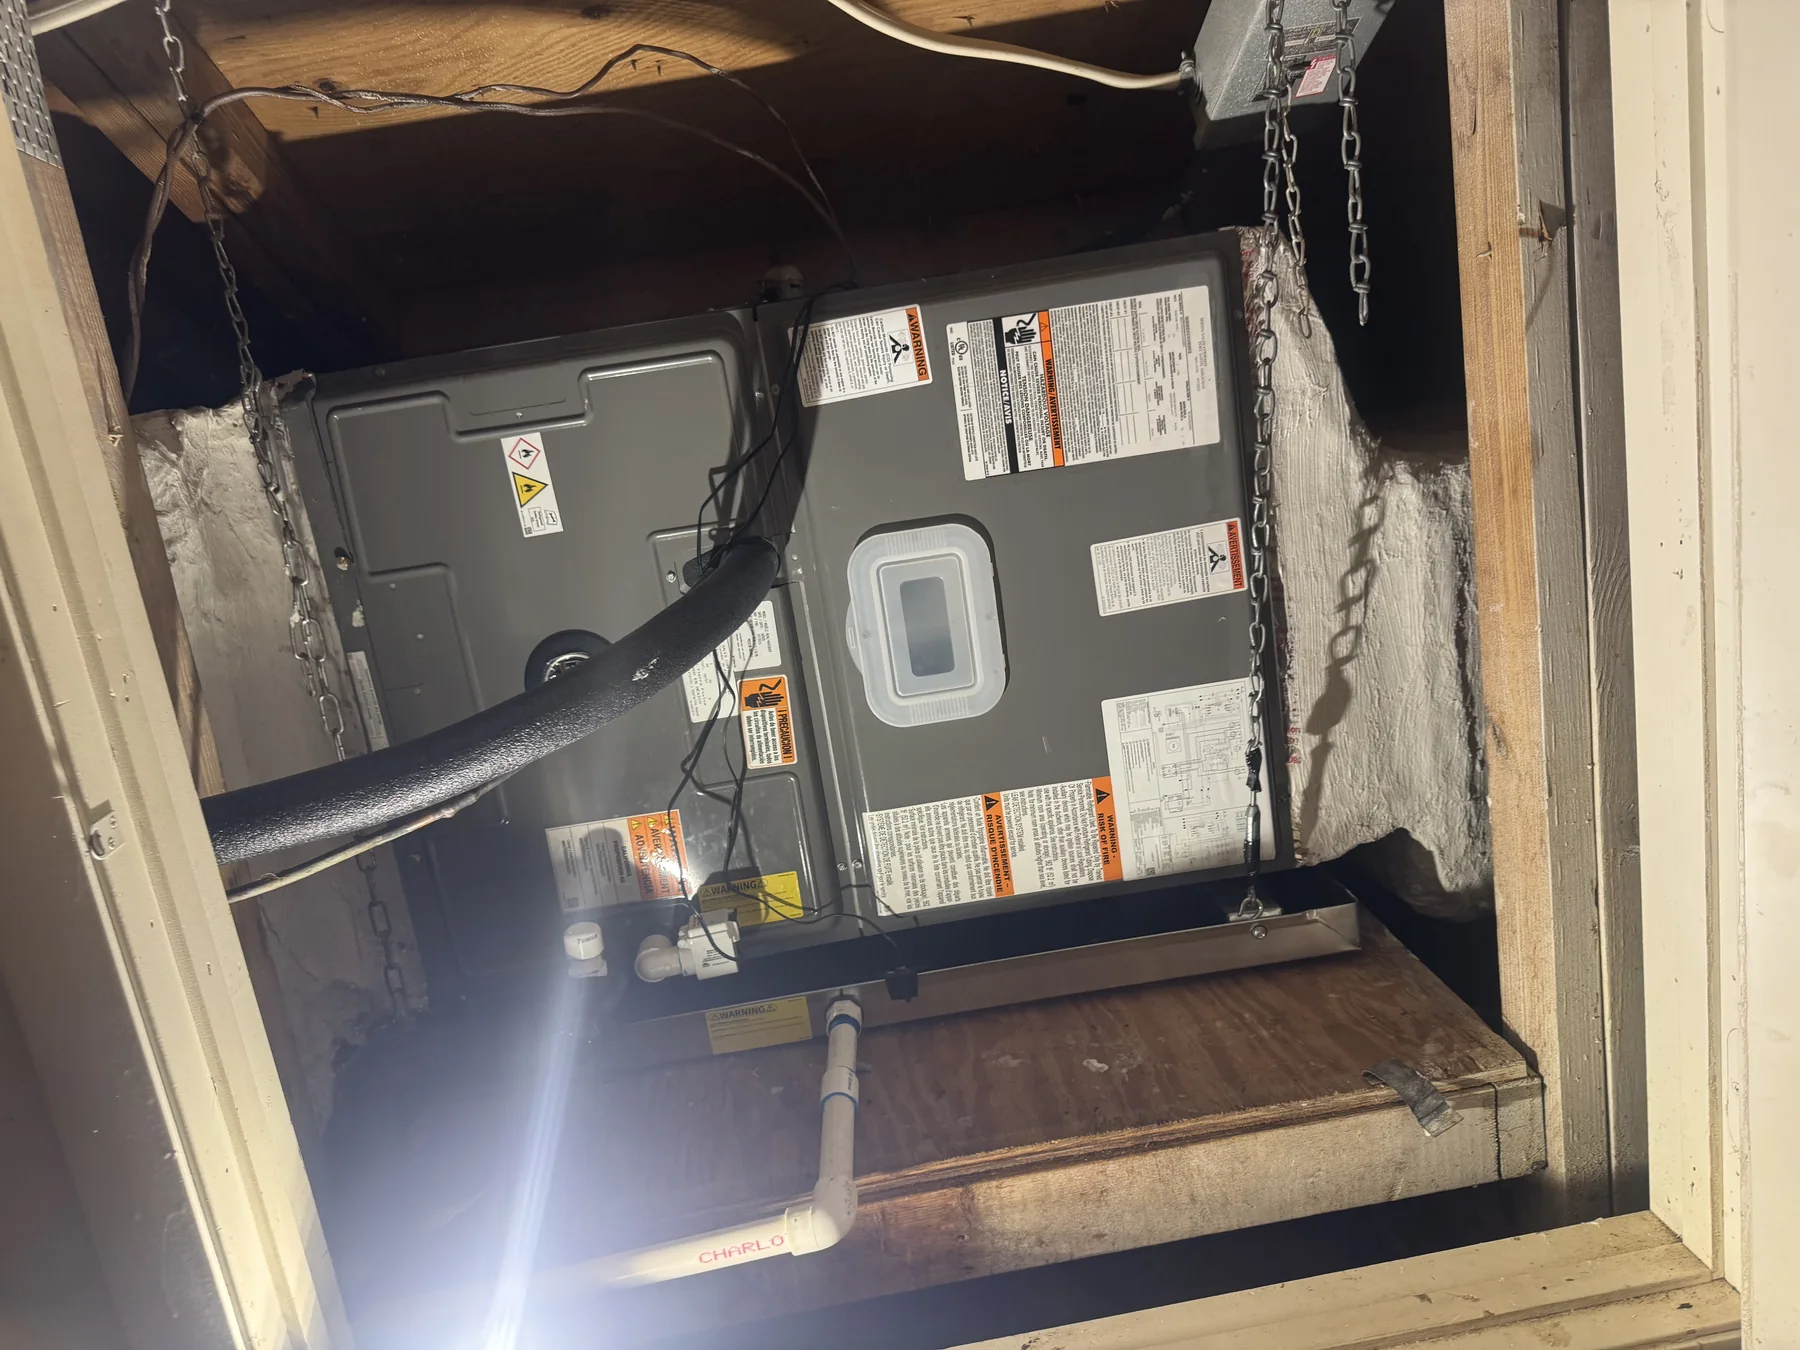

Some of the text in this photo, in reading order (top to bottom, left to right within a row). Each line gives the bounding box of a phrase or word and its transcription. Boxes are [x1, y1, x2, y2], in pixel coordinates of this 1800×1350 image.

[909, 320, 926, 376] WARNING
[999, 369, 1012, 424] NOTICE/AVIS
[1039, 373, 1047, 410] HAZARDOUS
[1044, 358, 1061, 449] WARNING/AVERTISSEMENT
[1024, 403, 1032, 440] DANGEREUSE
[1228, 531, 1242, 587] AVERTISSEMENT
[753, 717, 761, 734] circuitos
[759, 709, 768, 731] dispositivos
[778, 713, 791, 754] PRECAUCION
[985, 814, 1002, 892] RISQUE D'INCENDIE
[995, 814, 1010, 881] AVERTISSEMENT
[1097, 812, 1110, 865] RISK OF FIRE
[1106, 814, 1117, 853] WARNING
[612, 840, 624, 875] PROPOSITION
[621, 845, 631, 876] CALIFORNIA
[718, 1005, 765, 1019] WARNING
[697, 1233, 790, 1264] CHARLO
